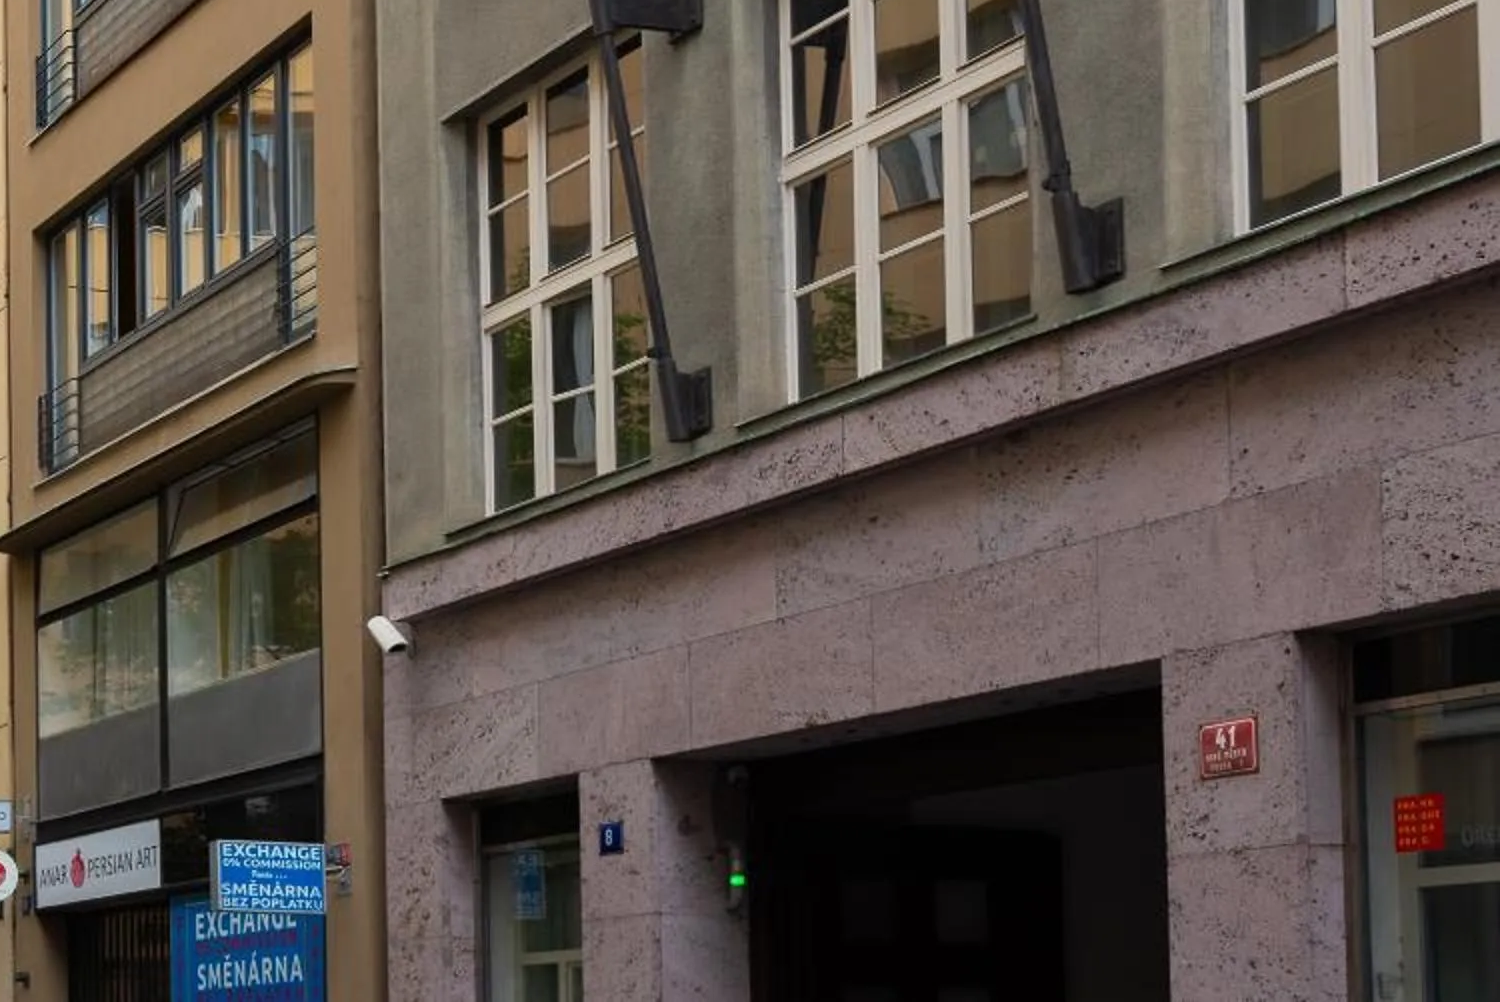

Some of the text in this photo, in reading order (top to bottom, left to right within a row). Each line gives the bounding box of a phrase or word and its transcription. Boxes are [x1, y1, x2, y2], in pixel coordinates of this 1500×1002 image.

[1215, 725, 1236, 748] 41
[605, 828, 613, 847] 8
[223, 843, 320, 860] EXCHANGE
[87, 851, 133, 878] PERSIAN
[137, 845, 158, 870] ART
[243, 859, 321, 871] COMMISSION
[221, 879, 323, 899] SMĚNÁRNA
[223, 898, 249, 908] BEZ
[197, 950, 304, 991] SMĚNÁRNA
